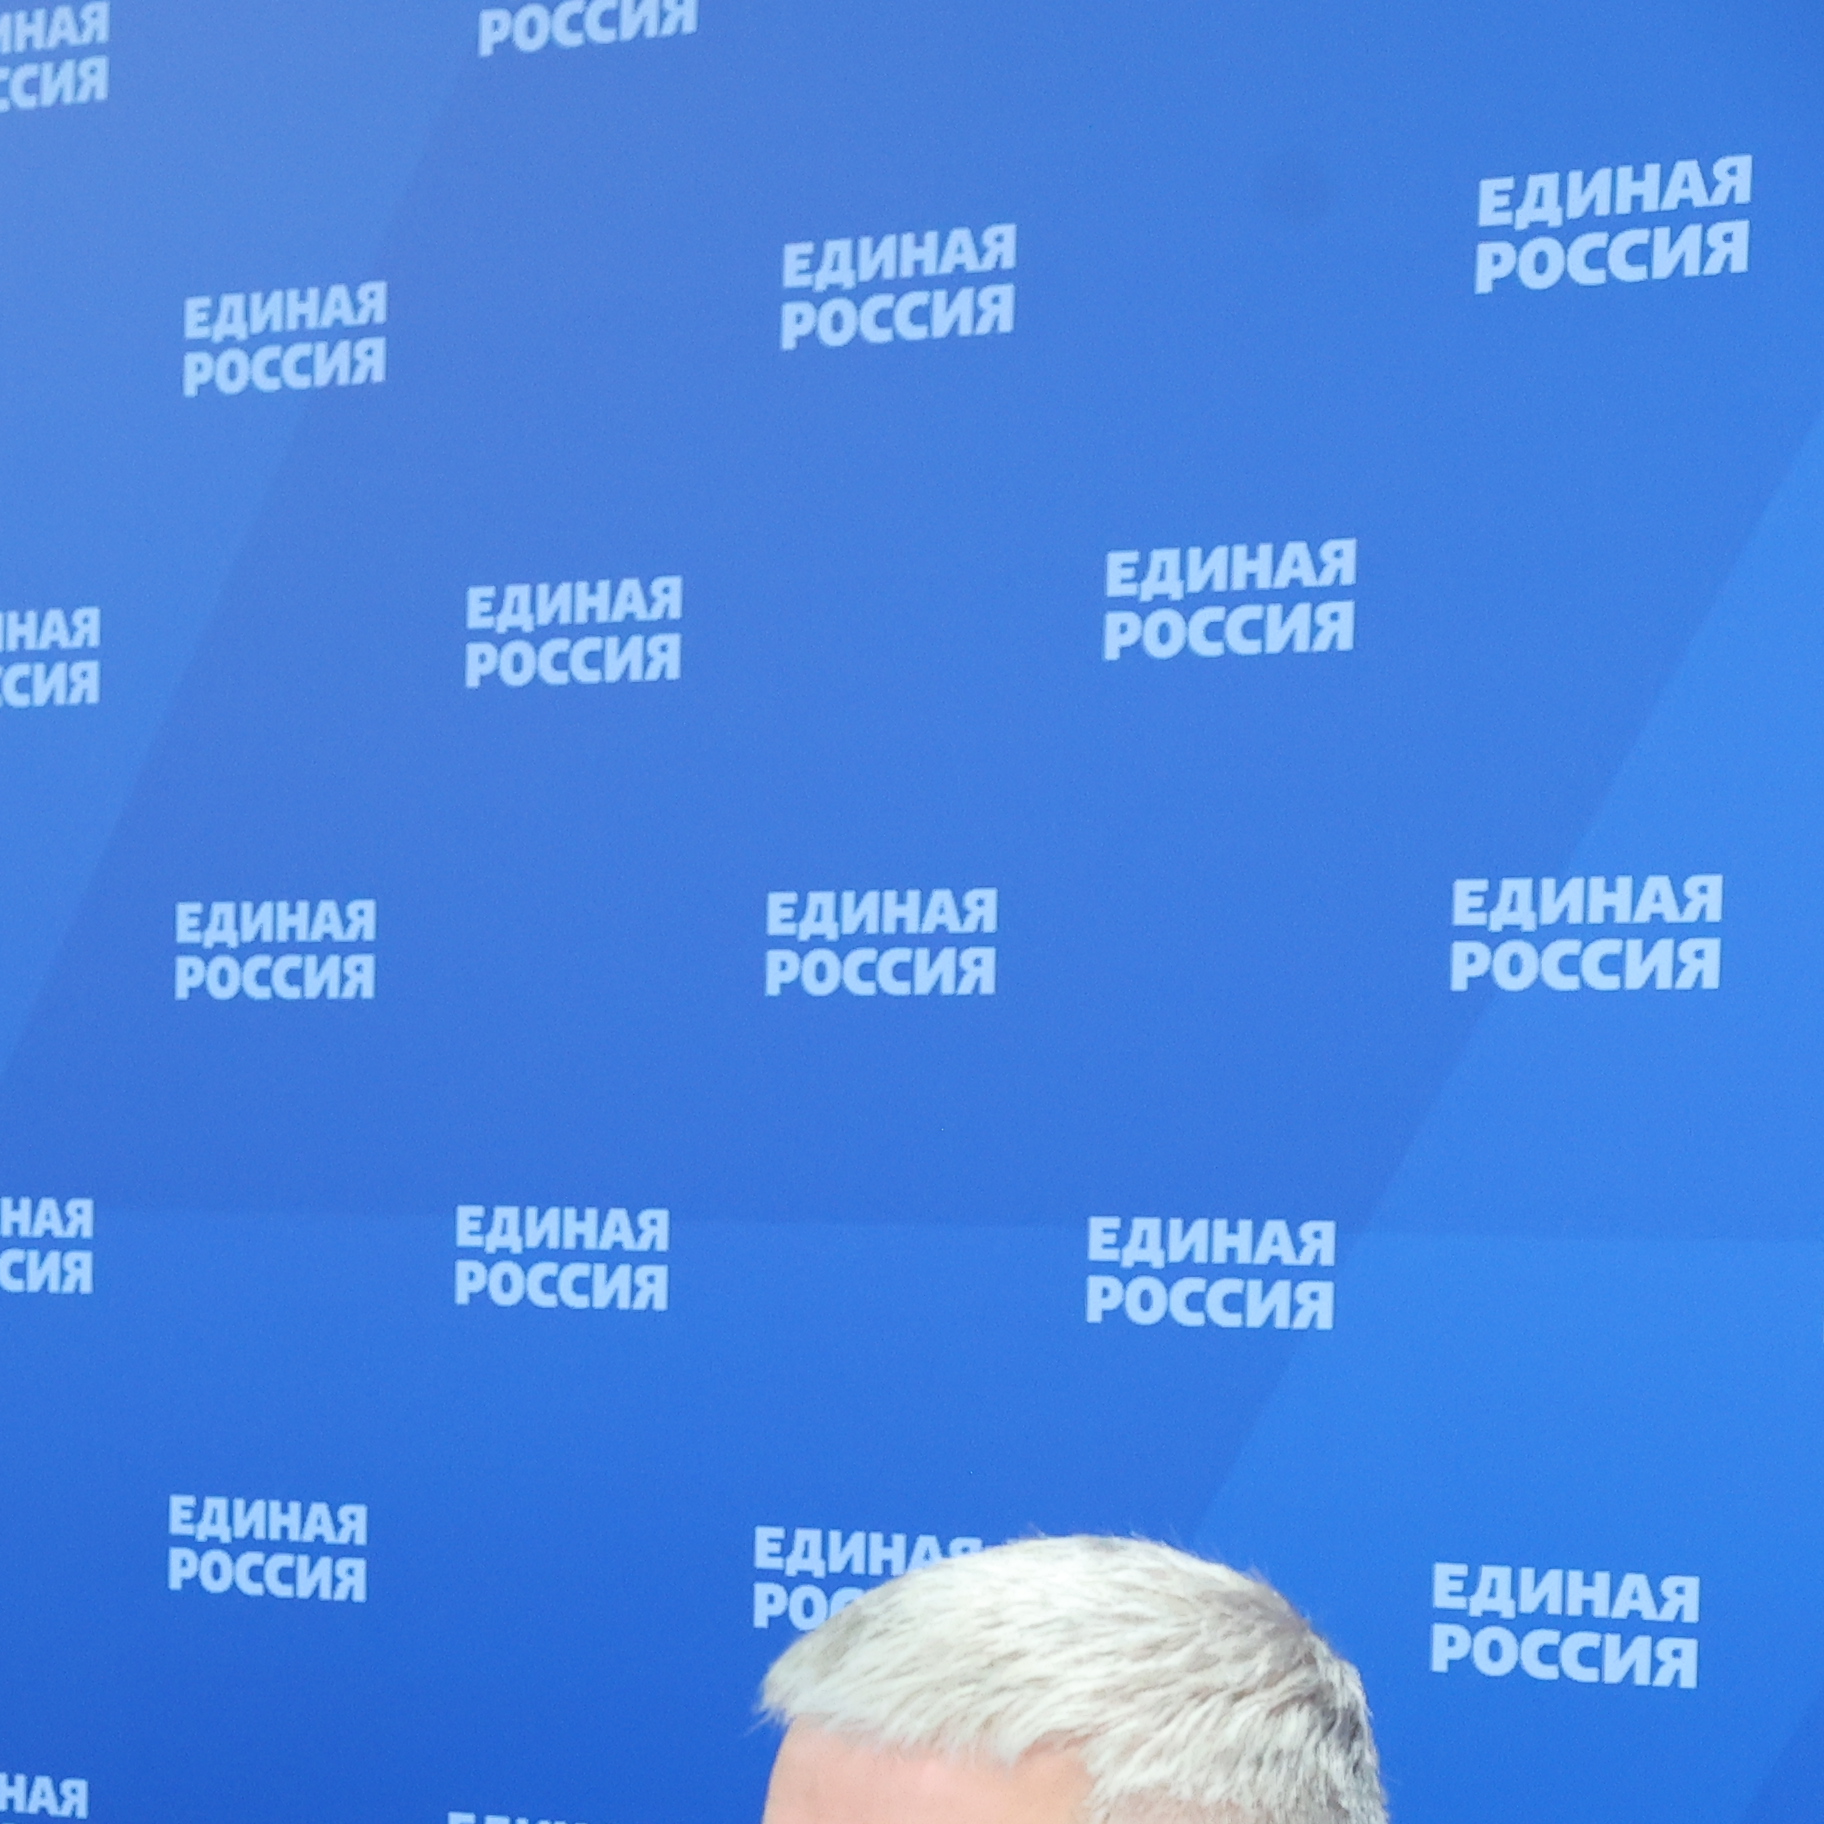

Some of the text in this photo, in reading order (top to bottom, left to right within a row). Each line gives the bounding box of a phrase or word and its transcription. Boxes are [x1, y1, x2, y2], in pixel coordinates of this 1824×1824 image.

[477, 0, 698, 57] РОССИЯ
[1477, 154, 1754, 231] ЕДИНАЯ
[782, 223, 1018, 291] ЕДИНАЯ
[1474, 219, 1751, 294] РОССИЯ
[184, 281, 388, 342] ЕДИНАЯ
[780, 284, 1016, 350] РОССИЯ
[183, 337, 387, 396] РОССИЯ
[1105, 538, 1358, 602] ЕДИНАЯ
[466, 576, 683, 634] ЕДИНАЯ
[1103, 600, 1356, 661] РОССИЯ
[464, 633, 682, 688] РОССИЯ
[175, 899, 377, 949] ЕДИНАЯ
[766, 888, 999, 941] ЕДИНАЯ
[1451, 874, 1724, 932] ЕДИНАЯ
[174, 954, 376, 1000] РОССИЯ
[764, 947, 997, 996] РОССИЯ
[1449, 937, 1722, 992] РОССИЯ
[455, 1205, 670, 1254] ЕДИНАЯ
[1087, 1216, 1337, 1269] ЕДИНАЯ
[454, 1259, 669, 1311] РОССИЯ
[1085, 1275, 1336, 1330] РОССИЯ
[168, 1494, 369, 1546] ЕДИНАЯ
[167, 1547, 368, 1603] РОССИЯ
[1432, 1562, 1701, 1623] ЕДИНАЯ
[1431, 1623, 1700, 1689] РОССИЯ
